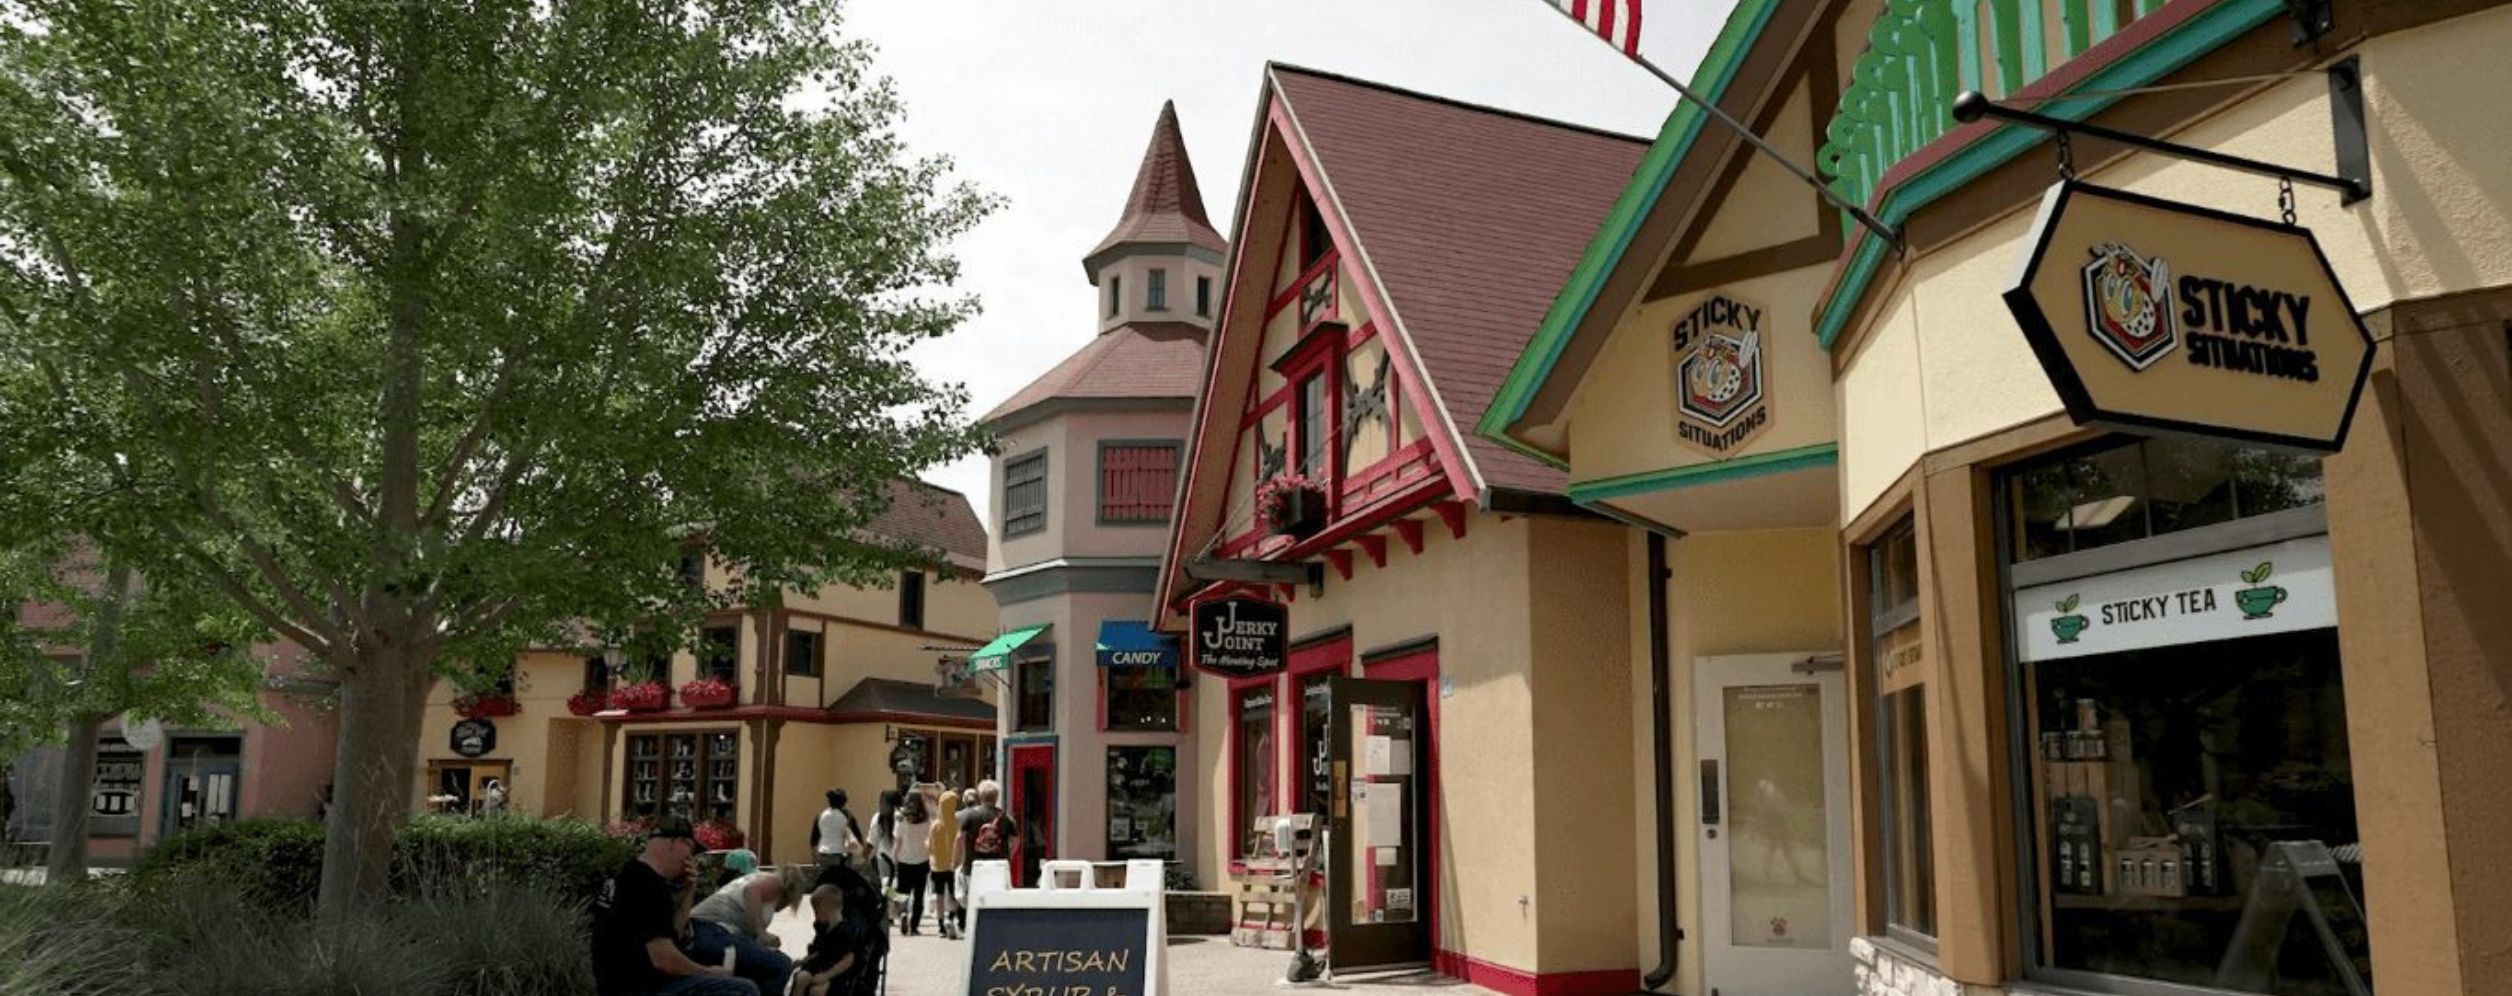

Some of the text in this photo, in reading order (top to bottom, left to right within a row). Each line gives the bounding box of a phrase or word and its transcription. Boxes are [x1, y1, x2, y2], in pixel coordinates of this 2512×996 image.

[1674, 296, 1761, 351] STICKY
[2179, 275, 2310, 346] STICKY
[2186, 331, 2319, 382] SITUATIONS
[1679, 405, 1766, 452] SITUATIONS
[1222, 601, 1278, 636] JERKY
[2175, 588, 2216, 614] TEA
[1203, 616, 1265, 651] JOINT
[1112, 652, 1161, 665] CANDY
[989, 948, 1129, 973] ARTISAN
